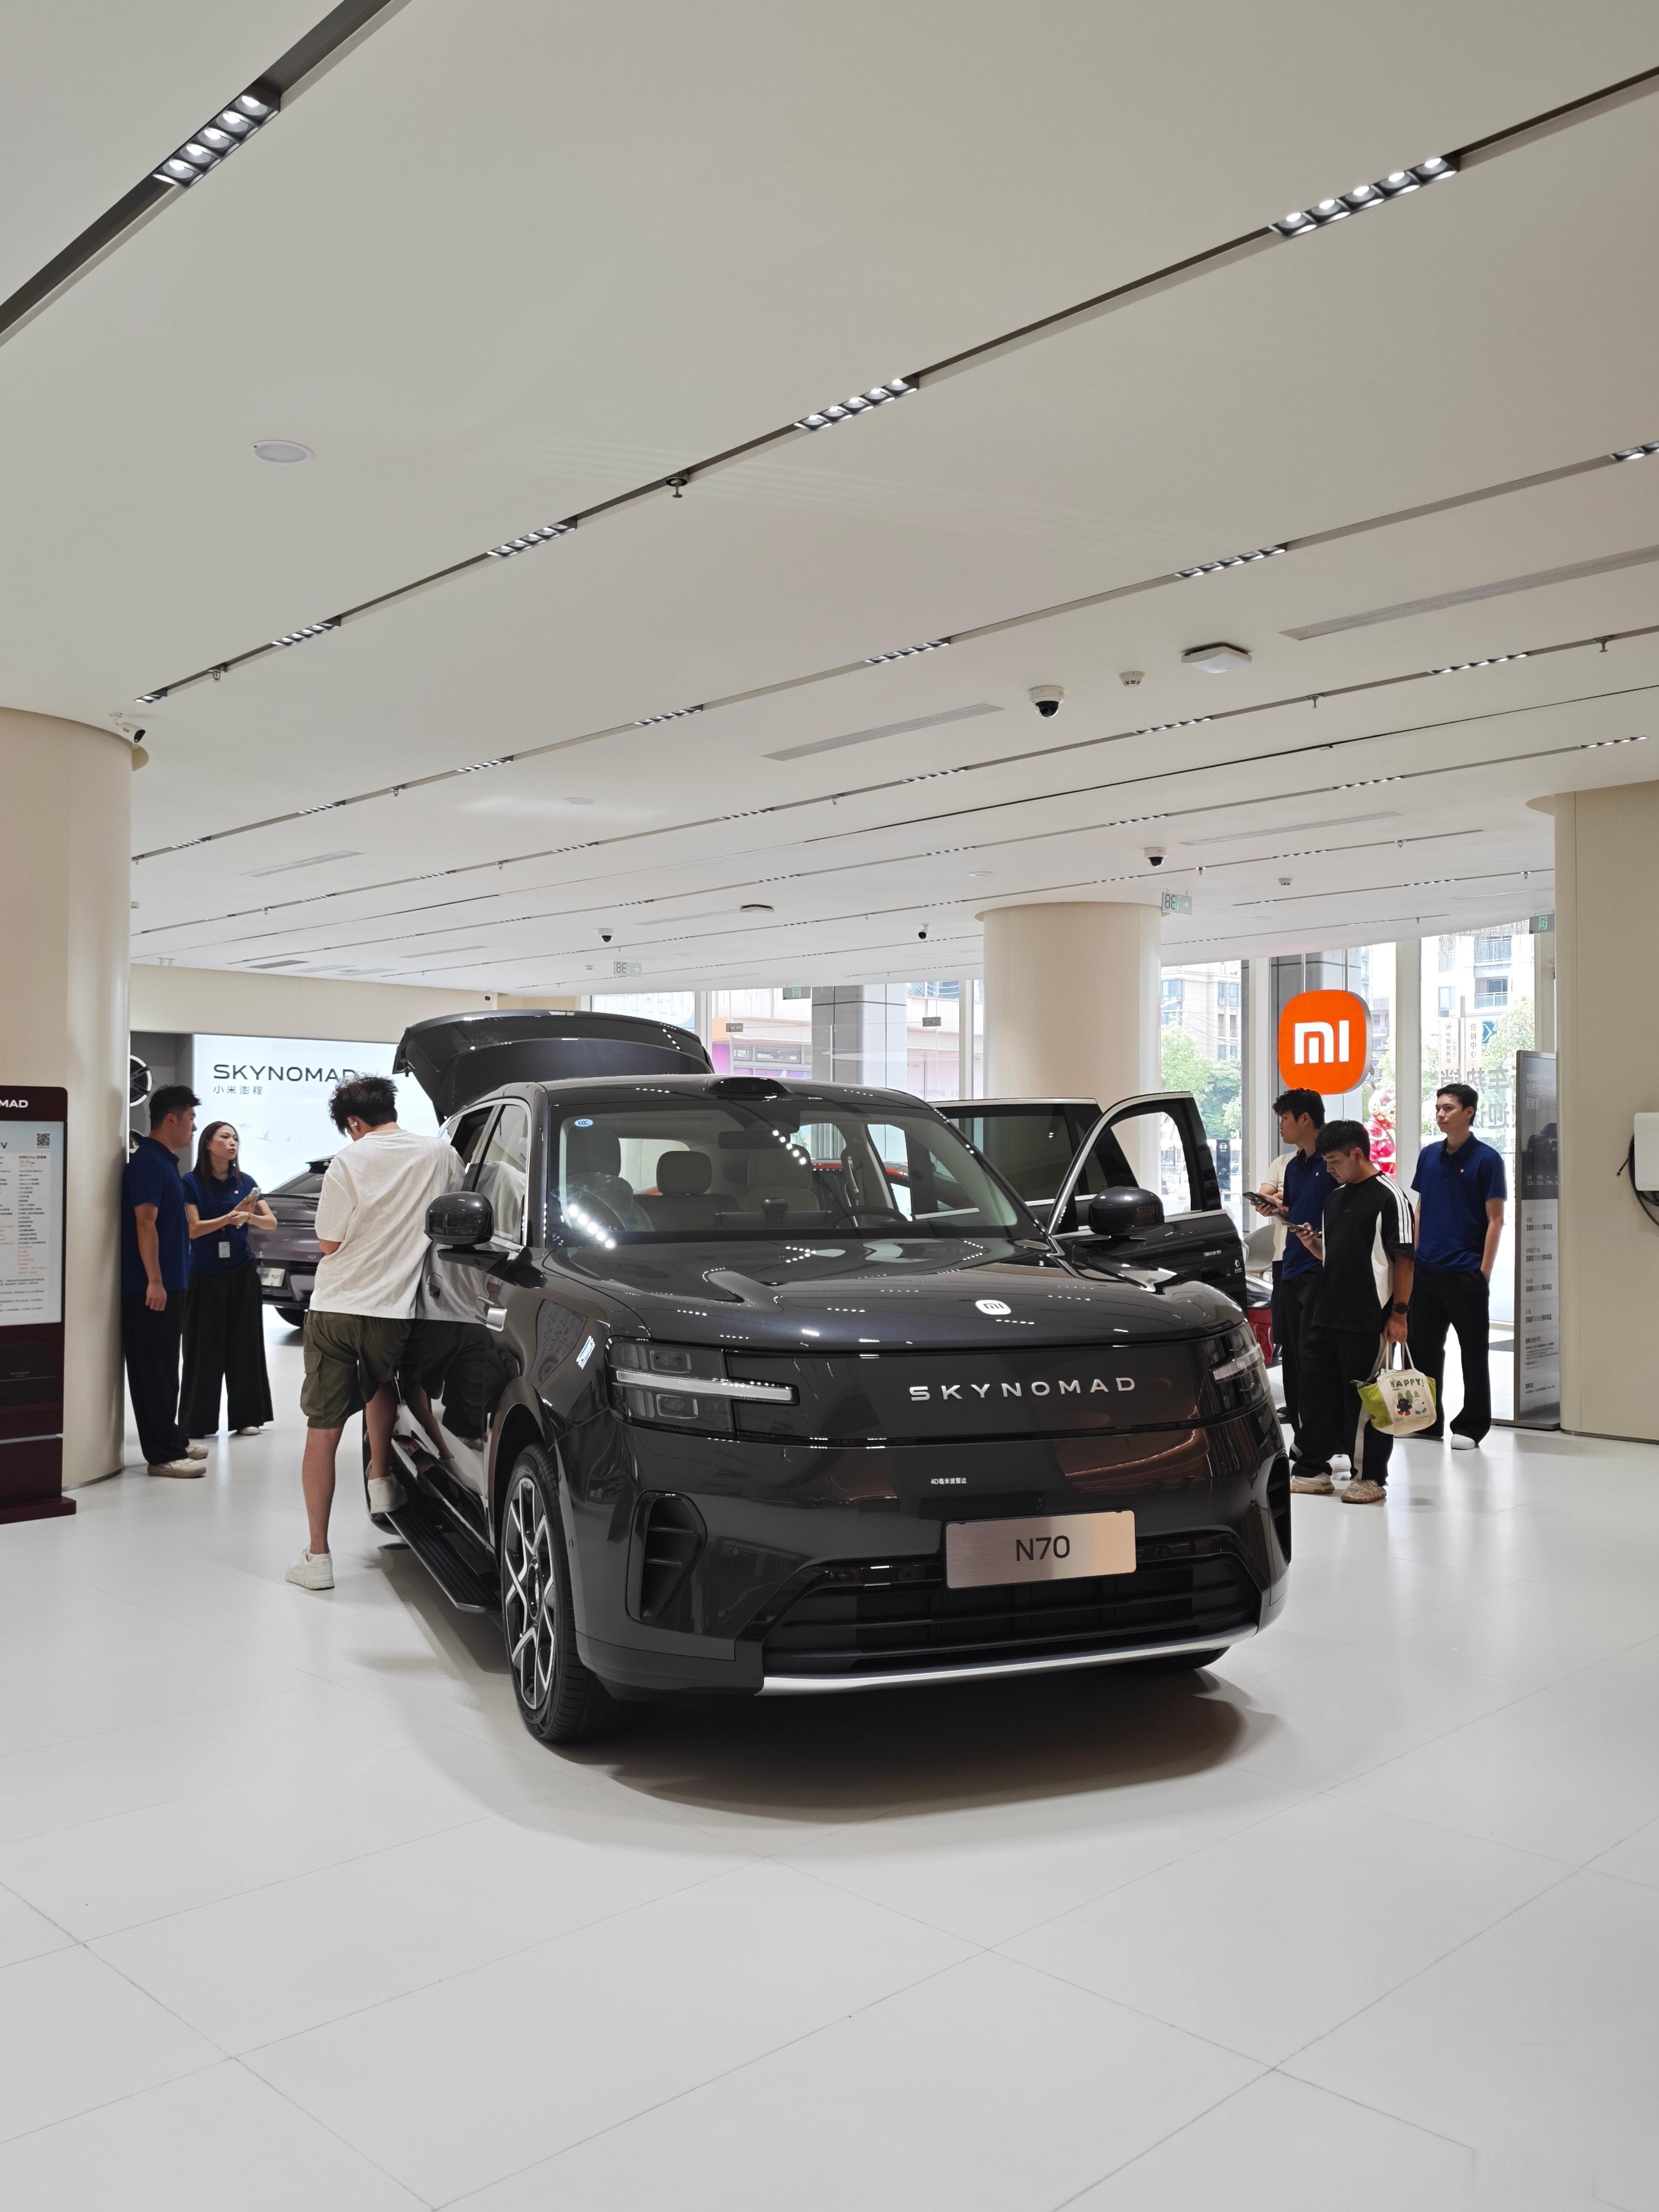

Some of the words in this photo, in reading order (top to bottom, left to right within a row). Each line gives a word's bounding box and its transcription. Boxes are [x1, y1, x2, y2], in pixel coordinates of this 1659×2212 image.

[909, 1377, 1136, 1401] SKYNOMAD
[1390, 1378, 1424, 1388] HAPPY!
[930, 1477, 967, 1485] 4D毫米波雷达
[1016, 1535, 1070, 1562] N70
